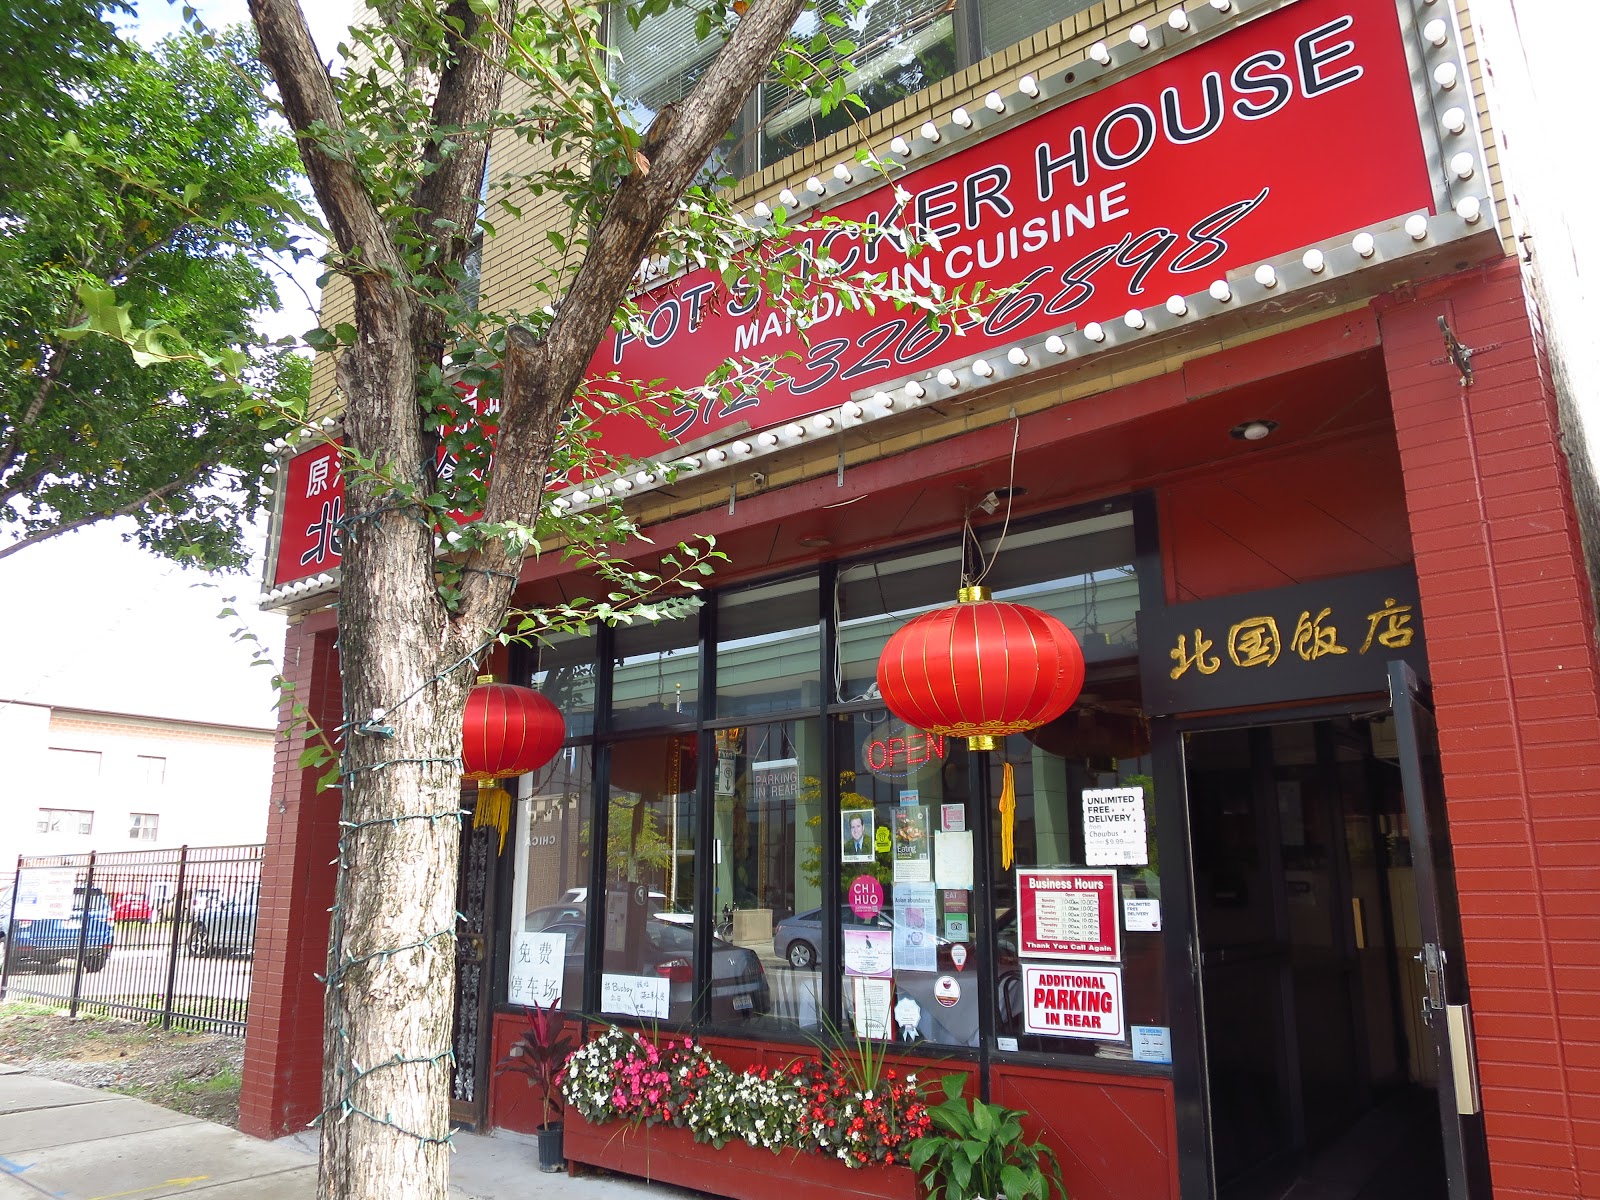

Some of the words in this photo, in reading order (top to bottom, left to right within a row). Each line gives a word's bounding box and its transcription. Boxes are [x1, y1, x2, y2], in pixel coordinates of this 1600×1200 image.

[613, 281, 715, 365] POT
[1035, 15, 1364, 202] HOUSE
[944, 182, 1129, 279] CUISINE
[867, 732, 944, 770] OPEN
[755, 772, 797, 786] PARKING
[755, 787, 766, 798] IN
[771, 784, 798, 797] REAR
[1087, 795, 1135, 804] UNLIMITED
[1087, 806, 1110, 814] FREE
[1088, 814, 1131, 823] DELIVERY
[1028, 877, 1072, 889] Business
[1074, 877, 1104, 890] Hours
[854, 895, 879, 905] HUO
[1026, 941, 1050, 949] Thank
[1089, 944, 1112, 952] Again
[1039, 974, 1106, 989] ADDITIONAL
[1033, 988, 1113, 1013] PARKING
[1045, 1012, 1060, 1026] IN
[1064, 1014, 1102, 1028] REAR
